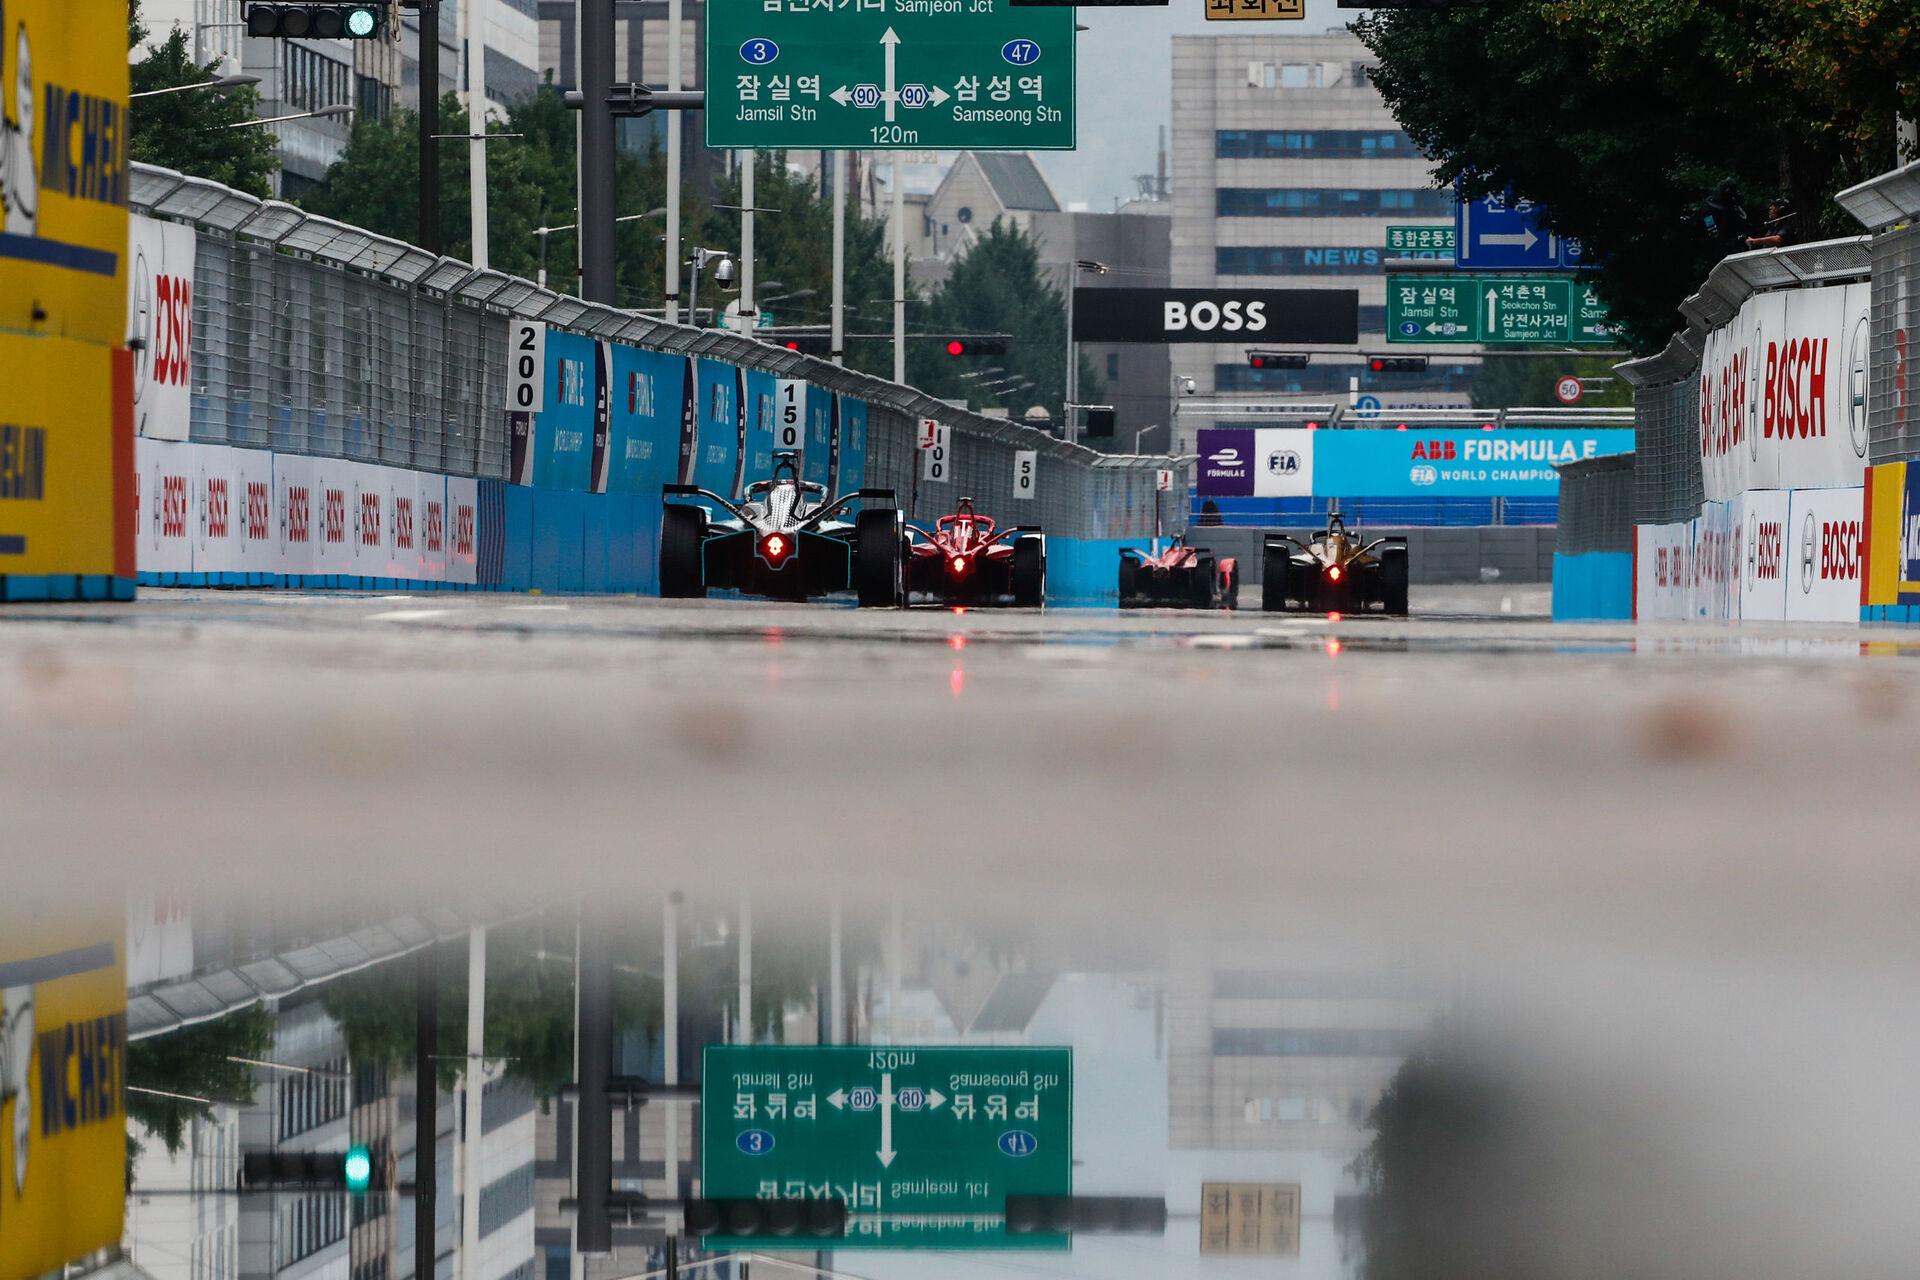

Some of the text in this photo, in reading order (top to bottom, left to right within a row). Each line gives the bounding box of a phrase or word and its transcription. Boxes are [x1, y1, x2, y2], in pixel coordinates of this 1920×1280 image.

[895, 0, 993, 16] Samjeon Jct
[754, 43, 767, 61] 3
[1011, 43, 1031, 62] 47
[736, 74, 821, 102] 잠실역
[856, 88, 875, 105] 90
[905, 88, 923, 105] 90
[953, 75, 1043, 102] 삼성역
[736, 105, 816, 121] Jamsil Stn
[953, 106, 1062, 125] Samseong Stn
[870, 127, 918, 143] 120m
[1304, 249, 1379, 266] NEWS
[1400, 287, 1456, 305] 잠실역
[1501, 285, 1546, 299] 석촌역
[1401, 306, 1458, 317] Jamsil Stn
[1501, 300, 1557, 310] Seokchon Stn
[1164, 300, 1267, 331] BOSS
[1502, 313, 1568, 328] 삼전사거리
[1406, 323, 1414, 334] 3
[1504, 328, 1557, 340] Samjeon Jct
[517, 327, 536, 407] 200
[1561, 384, 1577, 396] 50
[1764, 337, 1828, 440] BOSCH
[783, 383, 797, 446] 150
[1411, 440, 1597, 460] ABB FORMULA E
[1020, 460, 1031, 489] 50
[1441, 470, 1487, 481] WORLD
[1758, 522, 1782, 580] BOSCH
[1821, 521, 1862, 580] BOSCH
